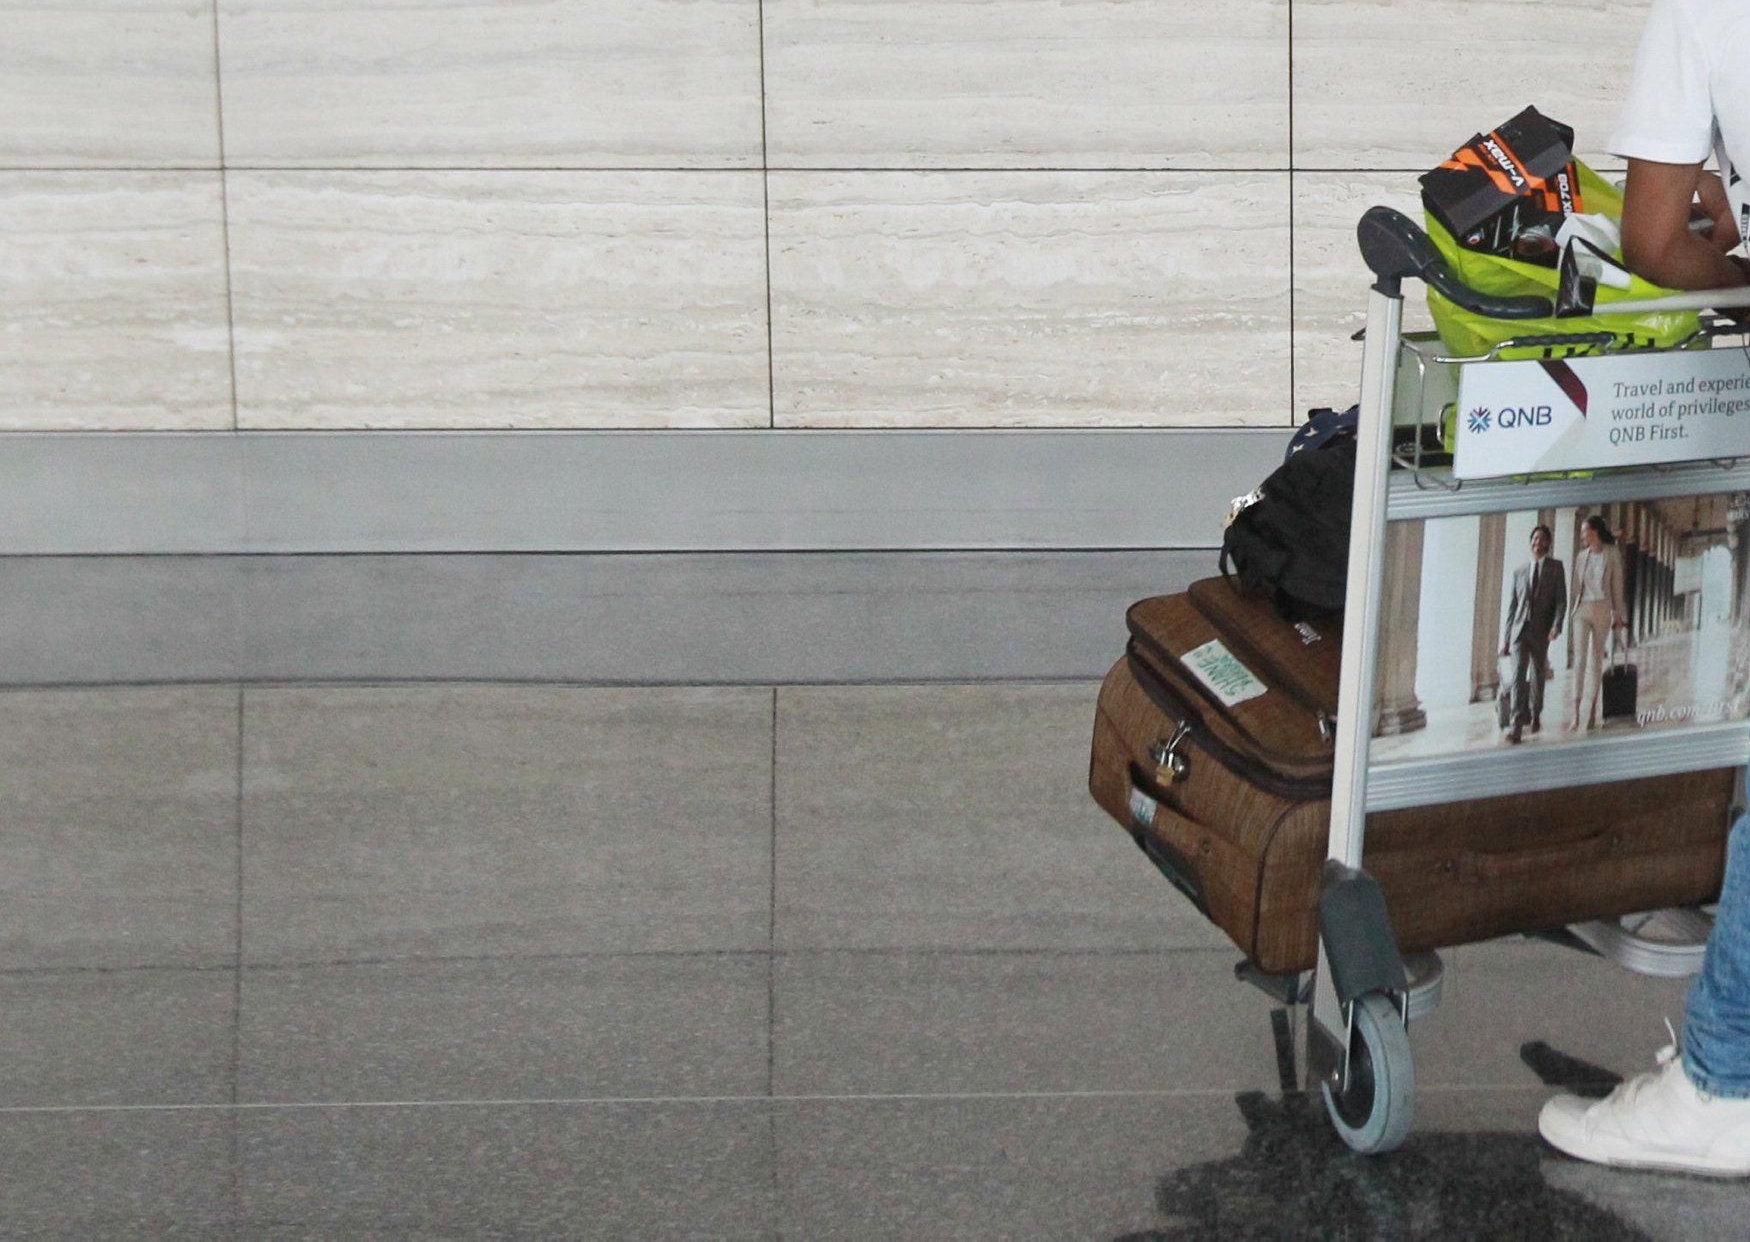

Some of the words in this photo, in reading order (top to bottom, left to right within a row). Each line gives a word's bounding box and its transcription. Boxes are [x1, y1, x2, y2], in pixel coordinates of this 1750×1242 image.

[1613, 379, 1663, 399] Travel
[1666, 376, 1695, 395] and
[1497, 405, 1552, 430] QNB
[1611, 402, 1655, 421] world
[1658, 400, 1675, 417] of
[1677, 397, 1750, 420] privileges
[1609, 426, 1646, 447] QNB
[1649, 424, 1690, 442] First.
